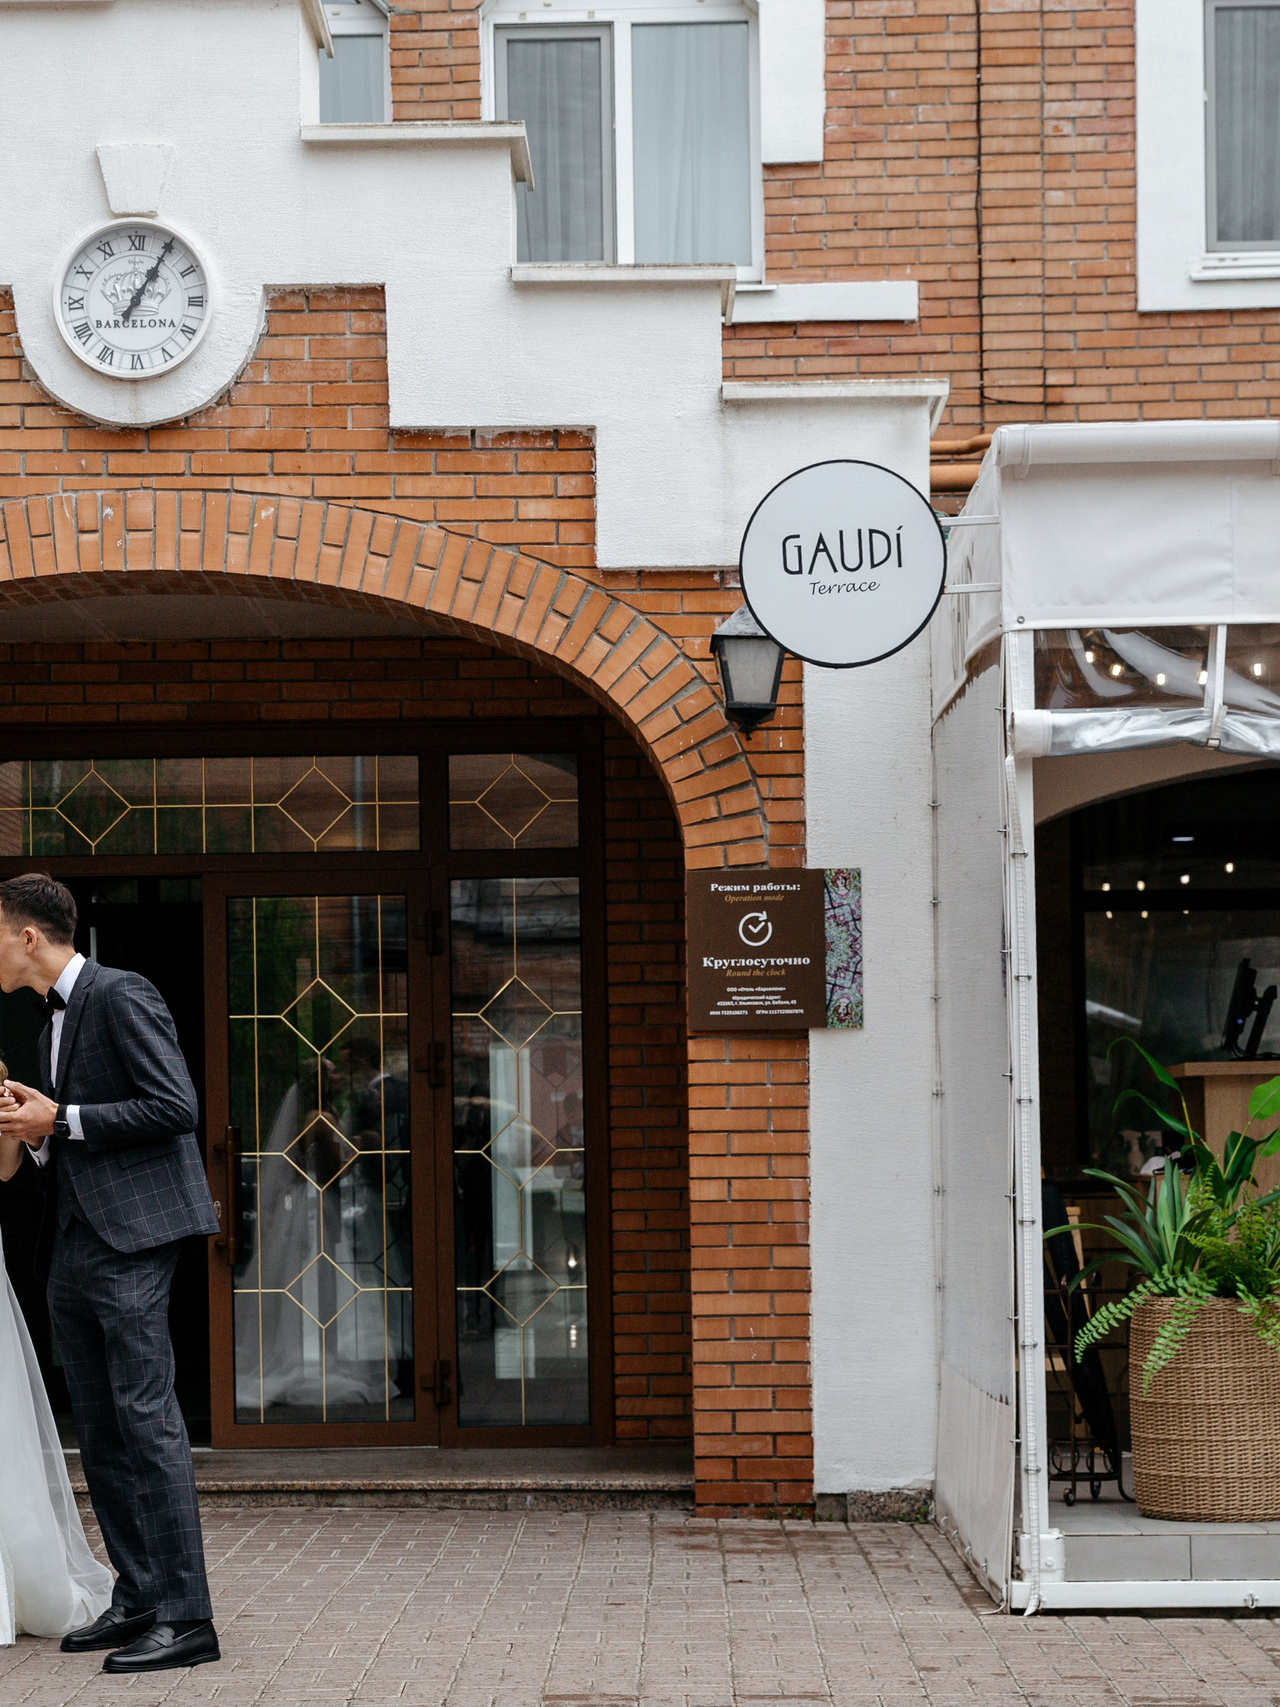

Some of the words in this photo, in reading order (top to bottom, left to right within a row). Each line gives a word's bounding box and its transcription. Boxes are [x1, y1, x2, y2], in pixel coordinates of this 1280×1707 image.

[128, 235, 146, 251] XII
[97, 242, 115, 261] XI
[76, 265, 93, 280] X
[180, 265, 195, 278] II
[69, 296, 84, 311] IX
[188, 296, 203, 307] III
[95, 319, 176, 328] BARCELONA
[74, 322, 93, 346] VIII
[180, 324, 196, 341] IV
[97, 346, 114, 365] VII
[131, 354, 144, 369] VI
[161, 347, 174, 362] V
[782, 525, 904, 575] GAUDÍ
[808, 581, 880, 595] Terrace
[753, 883, 801, 893] работы:
[725, 894, 762, 904] Operation
[702, 957, 810, 969] Круглосуточно
